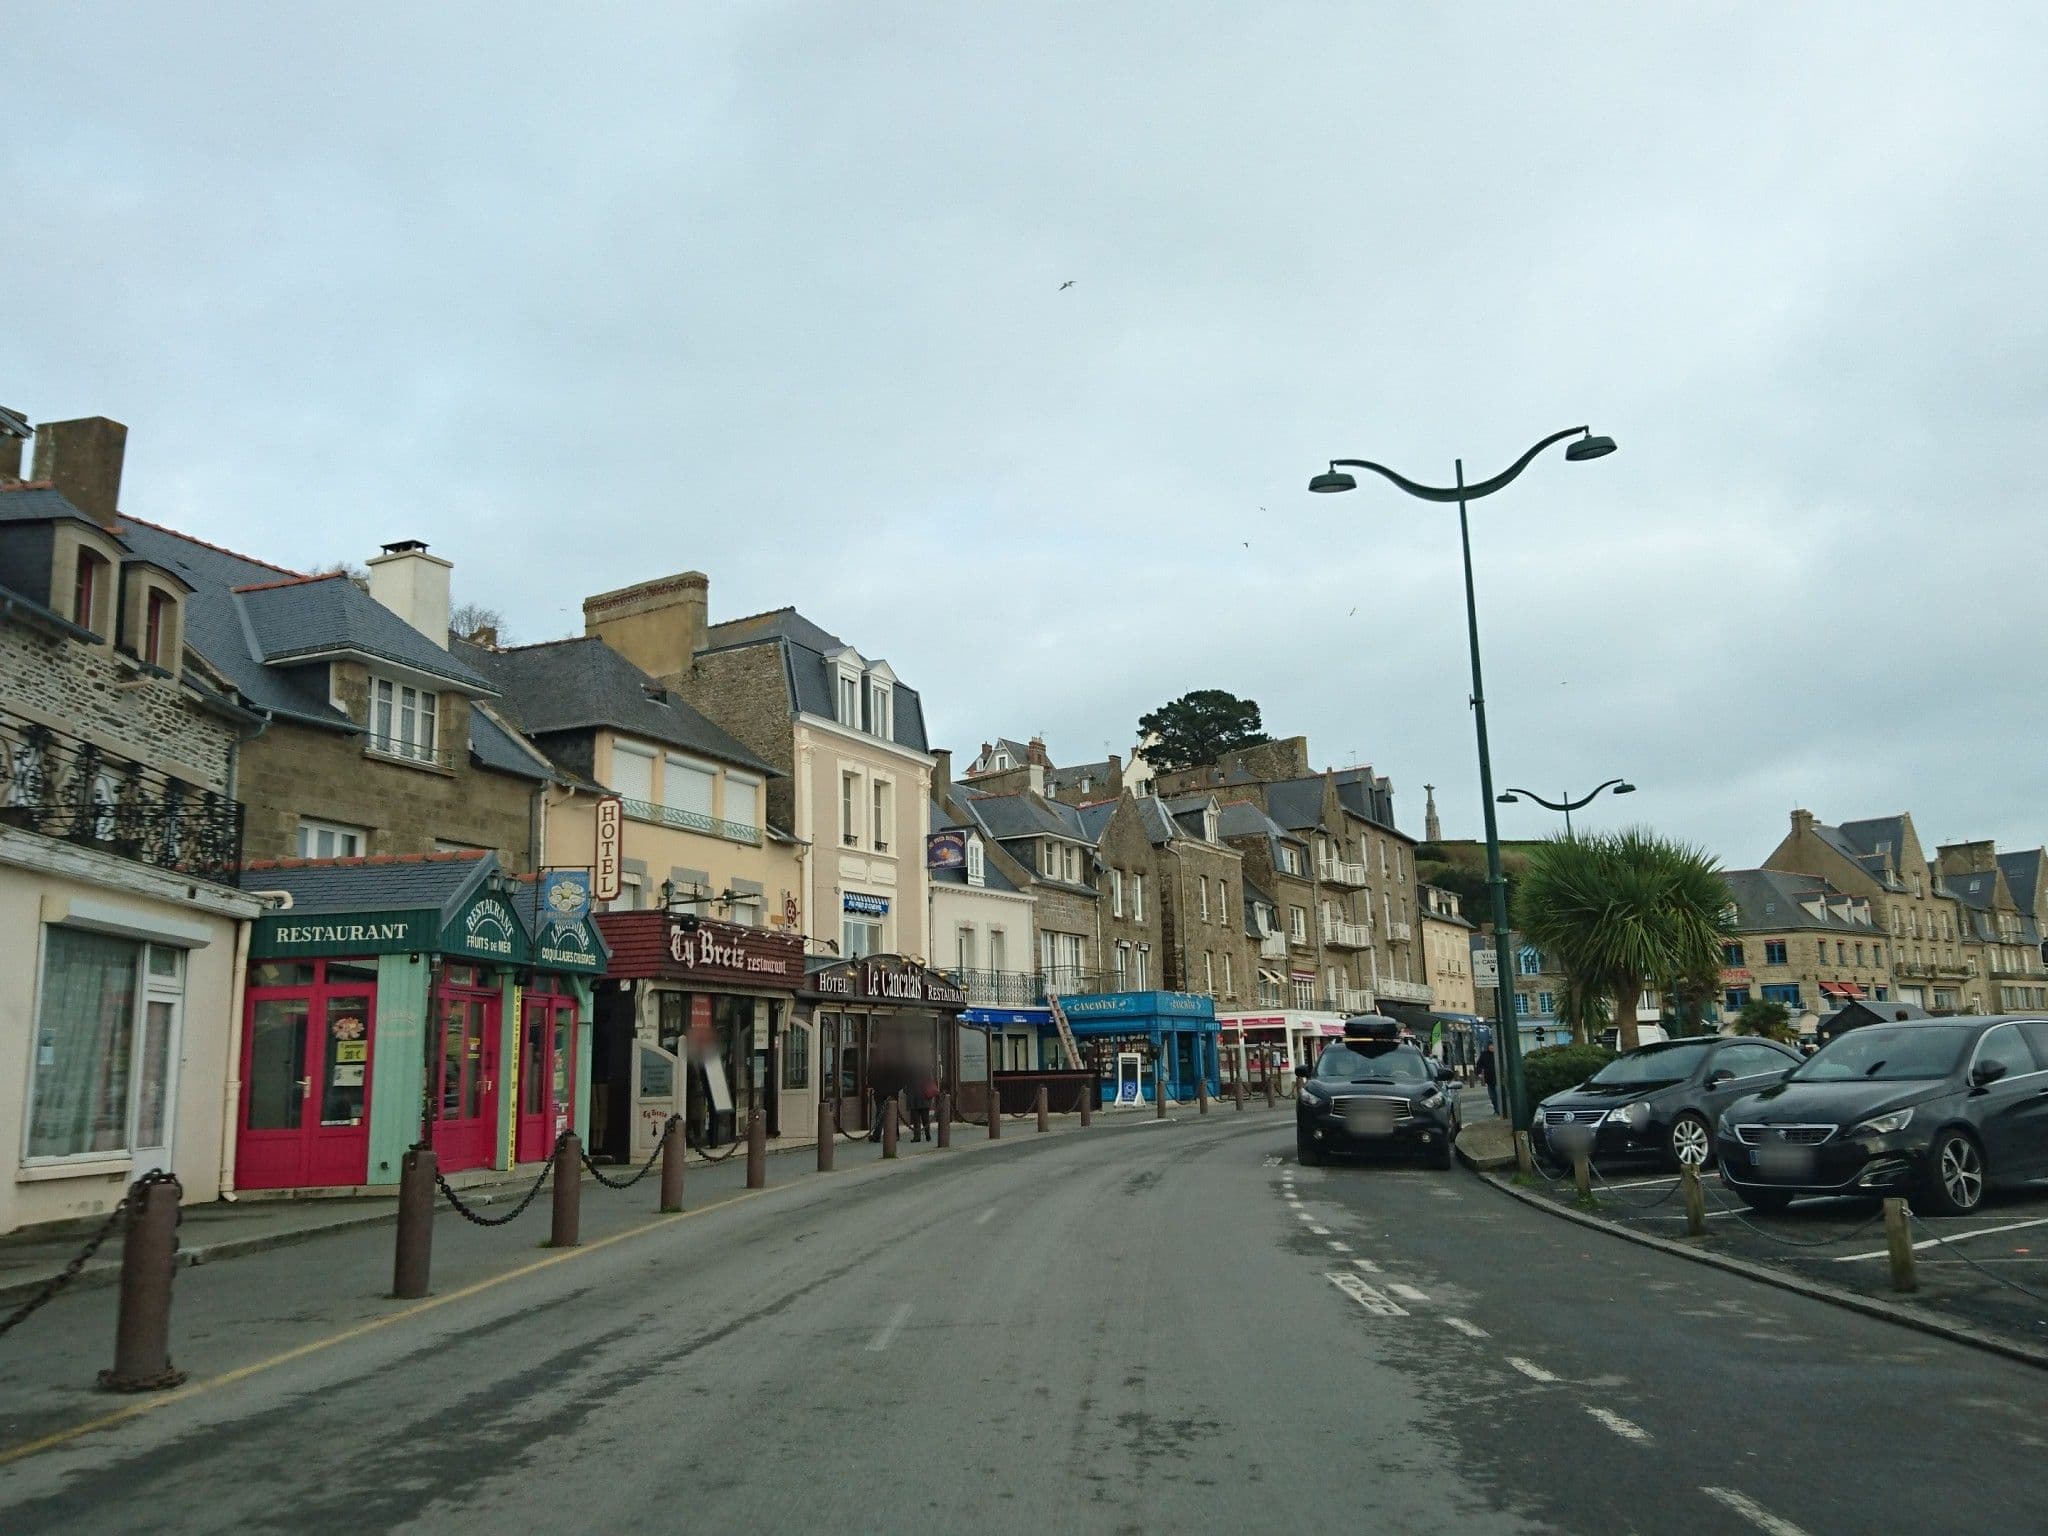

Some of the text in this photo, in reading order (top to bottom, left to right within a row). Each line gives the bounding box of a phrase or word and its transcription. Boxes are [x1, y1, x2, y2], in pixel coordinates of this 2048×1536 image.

[601, 806, 616, 893] HOTEL
[276, 923, 409, 943] RESTAURANT
[466, 899, 514, 938] RESTAURANT
[466, 935, 489, 950] FRUITS
[498, 940, 511, 953] MER
[670, 925, 694, 969] Ty
[697, 929, 745, 969] Breiz
[867, 962, 922, 999] Le Cancalais
[927, 984, 968, 1003] RESTAURANT
